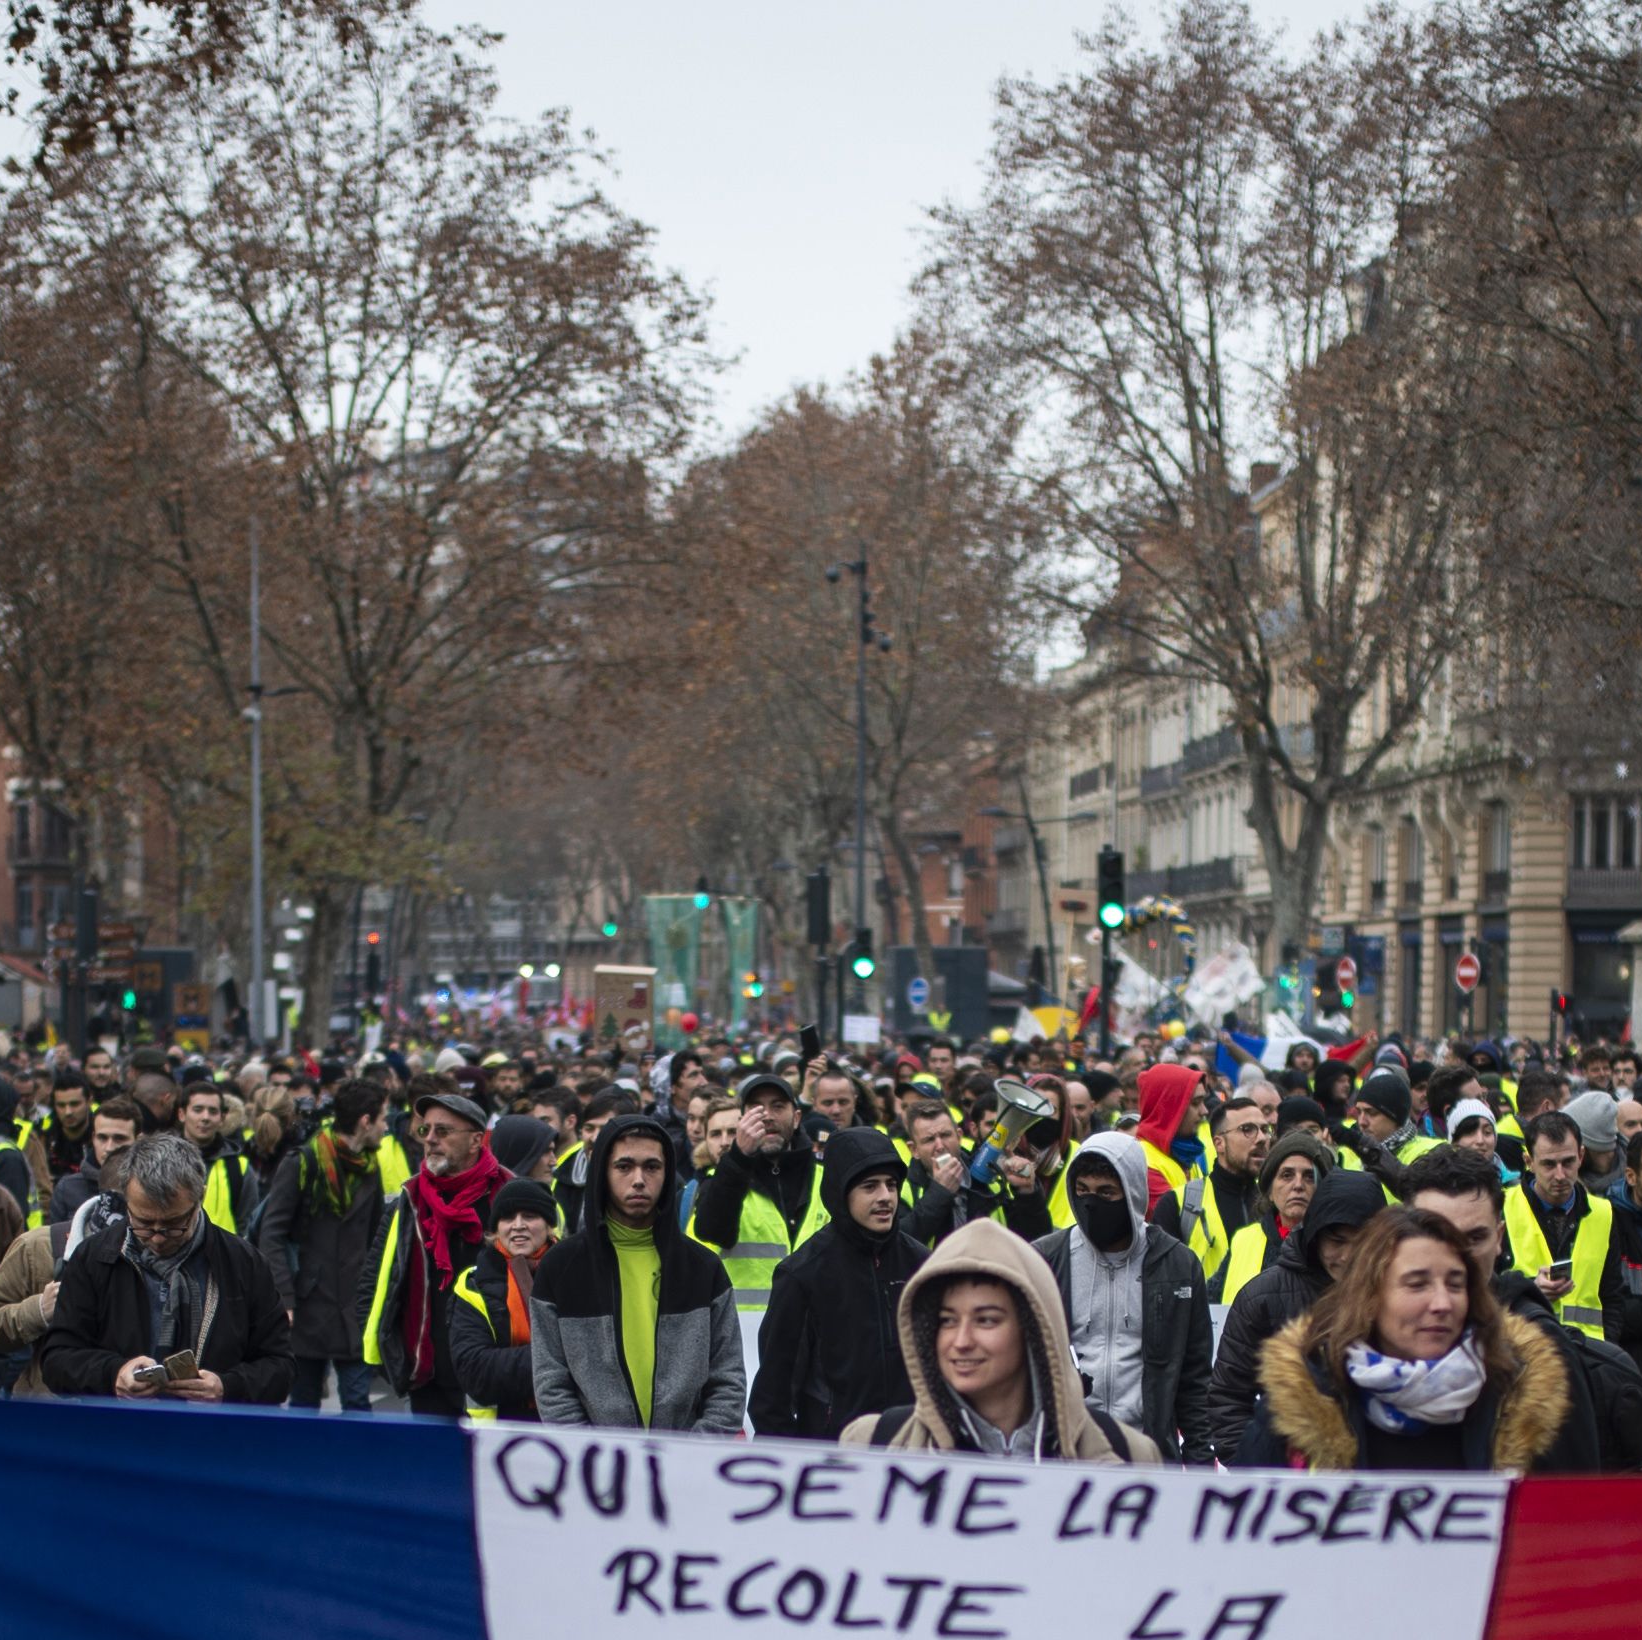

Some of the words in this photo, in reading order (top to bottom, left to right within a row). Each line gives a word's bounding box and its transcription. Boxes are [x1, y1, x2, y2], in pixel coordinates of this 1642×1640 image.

[494, 1436, 669, 1527] QUI
[1056, 1479, 1160, 1540] LA
[604, 1548, 1020, 1639] RECOLTE
